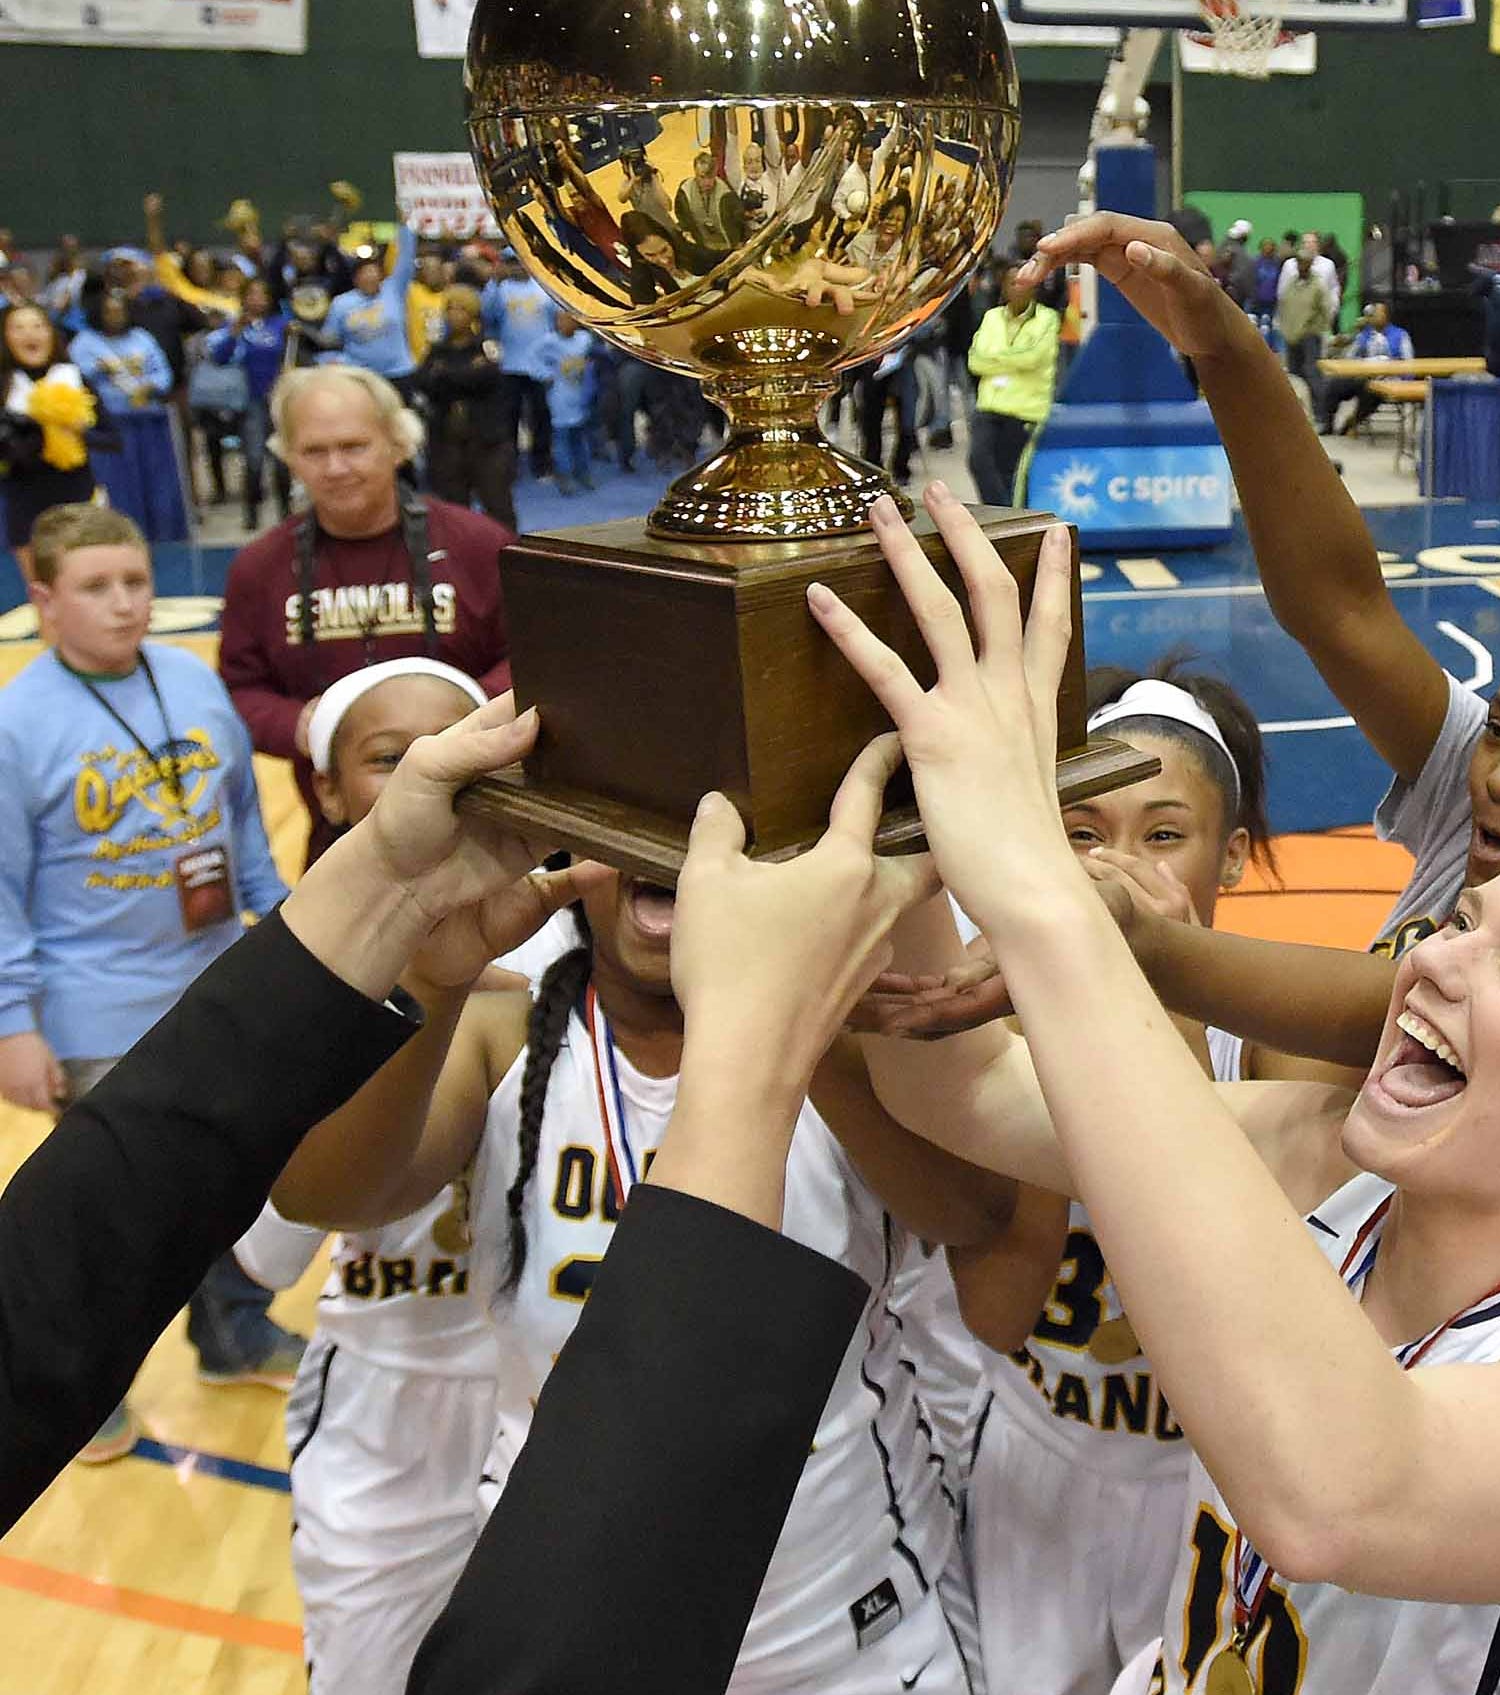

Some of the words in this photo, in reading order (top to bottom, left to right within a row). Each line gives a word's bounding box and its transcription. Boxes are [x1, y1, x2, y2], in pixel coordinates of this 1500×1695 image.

[1107, 476, 1131, 502] c
[1134, 474, 1221, 506] spire
[862, 1595, 887, 1621] XL
